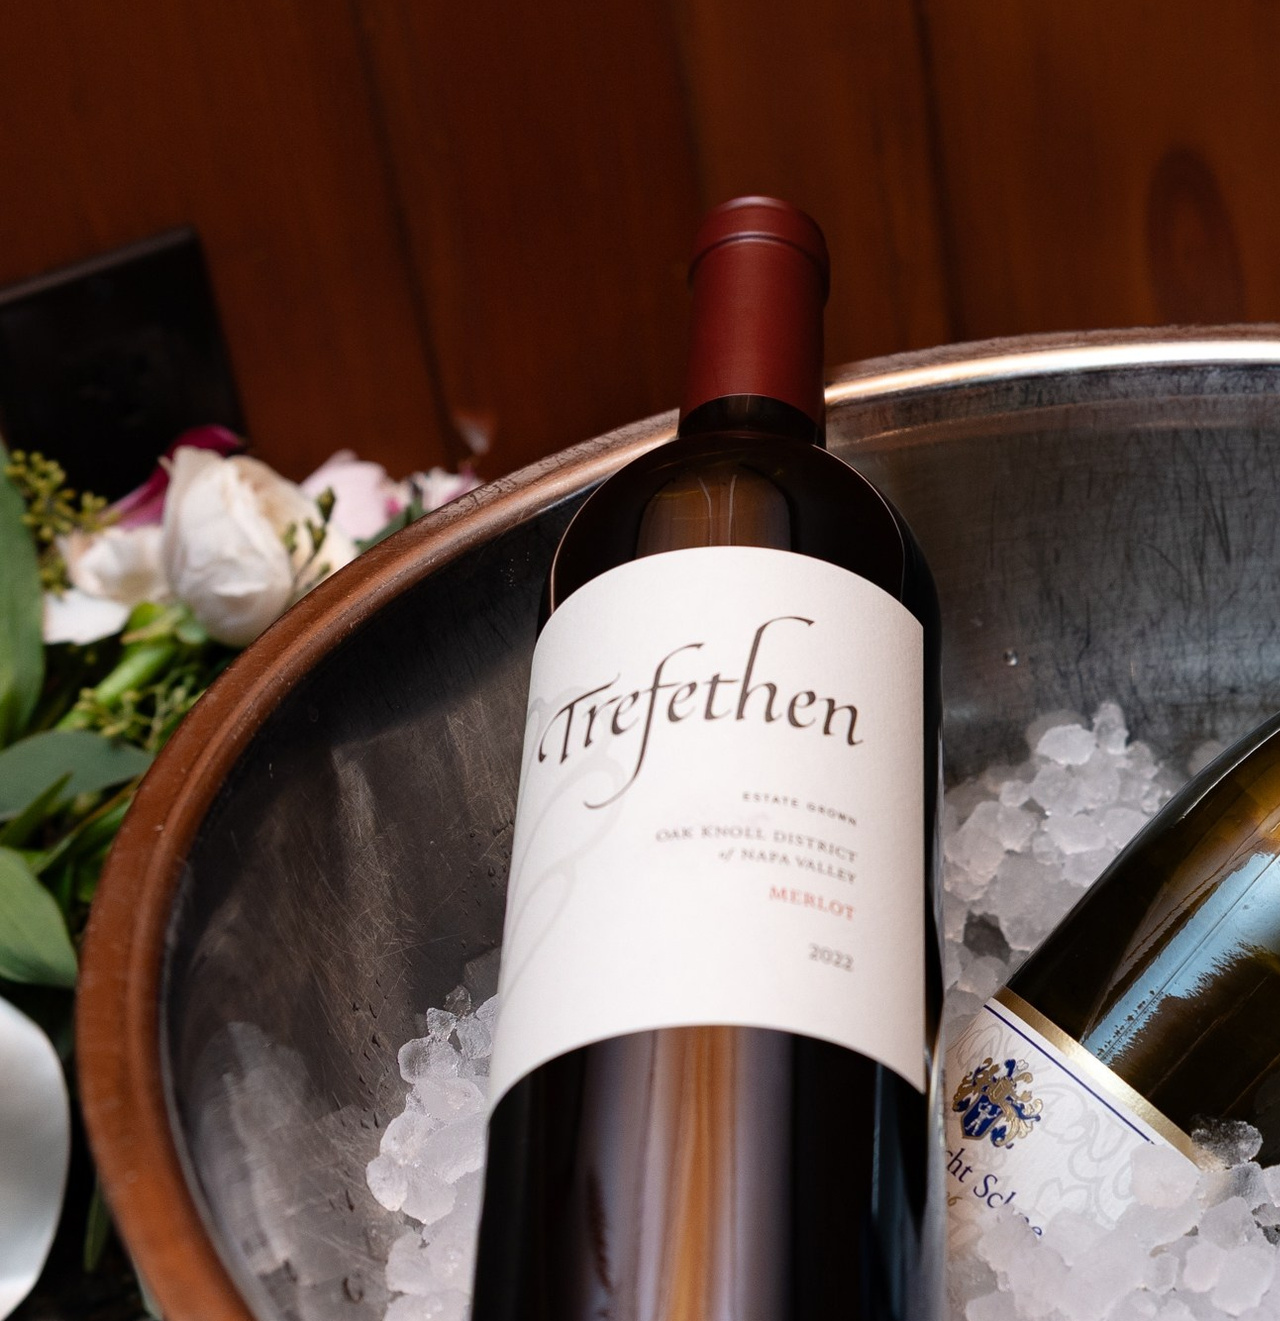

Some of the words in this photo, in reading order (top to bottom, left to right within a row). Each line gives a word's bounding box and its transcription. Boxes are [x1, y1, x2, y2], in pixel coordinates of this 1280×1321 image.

[537, 615, 864, 810] Trefethen
[742, 791, 799, 809] ESTATE
[806, 802, 857, 826] GROWN
[656, 826, 693, 842] OAK
[701, 825, 765, 841] KNOLL
[773, 830, 858, 863] DISTRICT
[740, 848, 790, 865] NAPA
[795, 855, 857, 885] VALLEY
[769, 885, 856, 921] MERLOT
[808, 942, 855, 972] 2022
